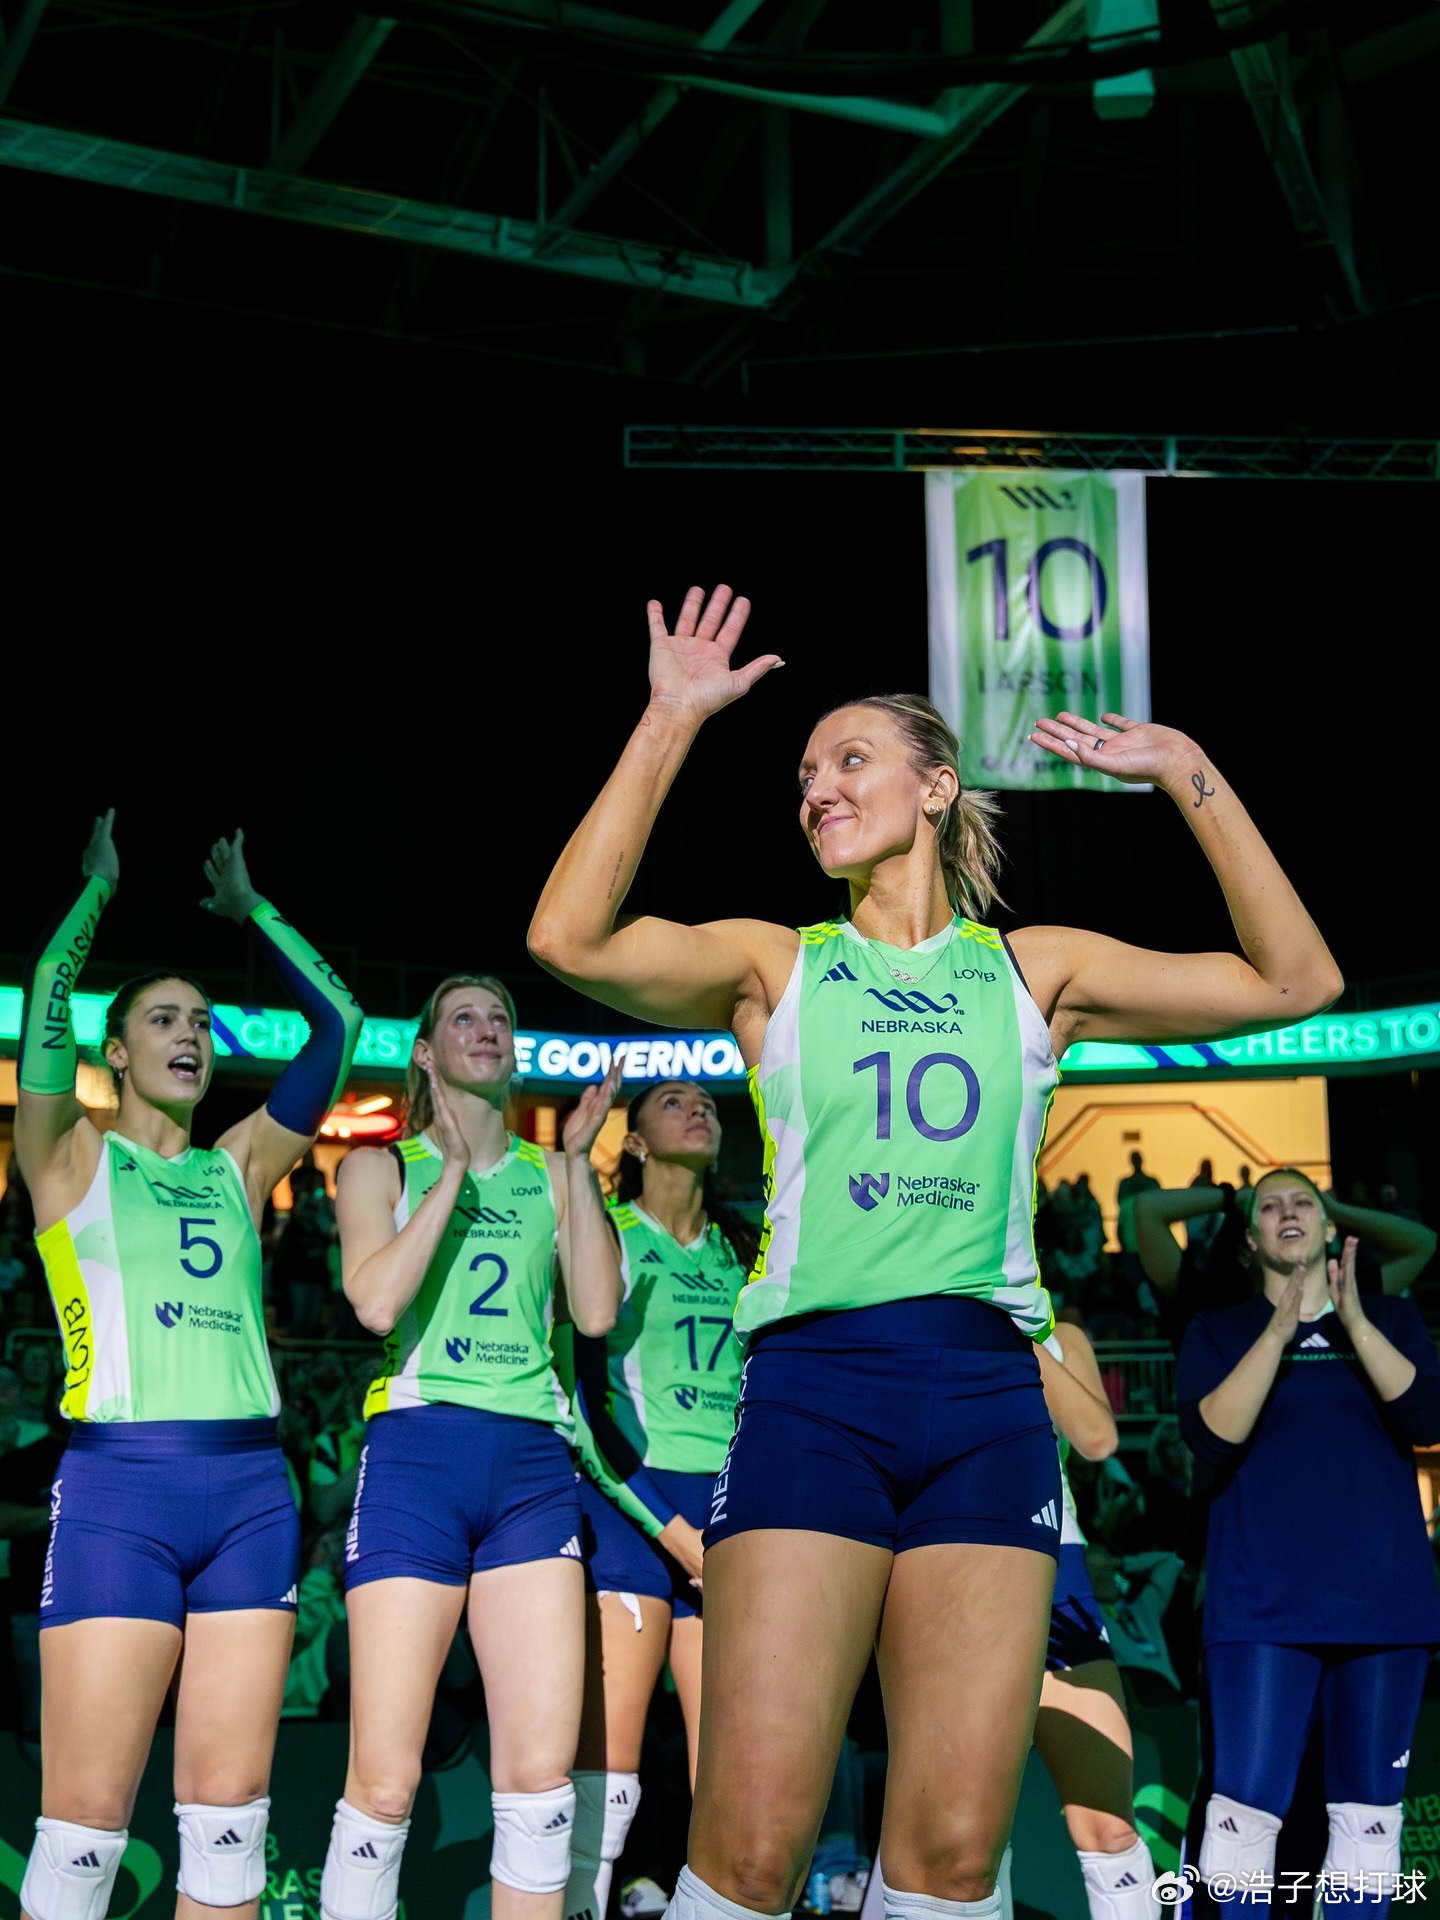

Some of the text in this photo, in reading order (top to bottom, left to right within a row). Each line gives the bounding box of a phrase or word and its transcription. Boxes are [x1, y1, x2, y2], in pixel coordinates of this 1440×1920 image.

[966, 537, 1108, 642] 10
[977, 669, 1099, 696] LARSON
[954, 967, 997, 983] LOVB
[861, 1019, 963, 1034] NEBRASKA
[538, 1038, 746, 1078] GOVERNO
[852, 1051, 981, 1142] 10
[511, 1185, 543, 1196] LOVB
[897, 1175, 977, 1195] Nebraska
[896, 1192, 975, 1212] Medicine
[453, 1229, 521, 1240] NEBRASKA
[179, 1217, 223, 1279] 5
[469, 1253, 509, 1317] 2
[188, 1304, 243, 1322] Nebraska
[188, 1317, 241, 1334] Medicine
[475, 1340, 529, 1354] Nebraska
[674, 1315, 733, 1372] 17
[475, 1353, 528, 1366] Medicine
